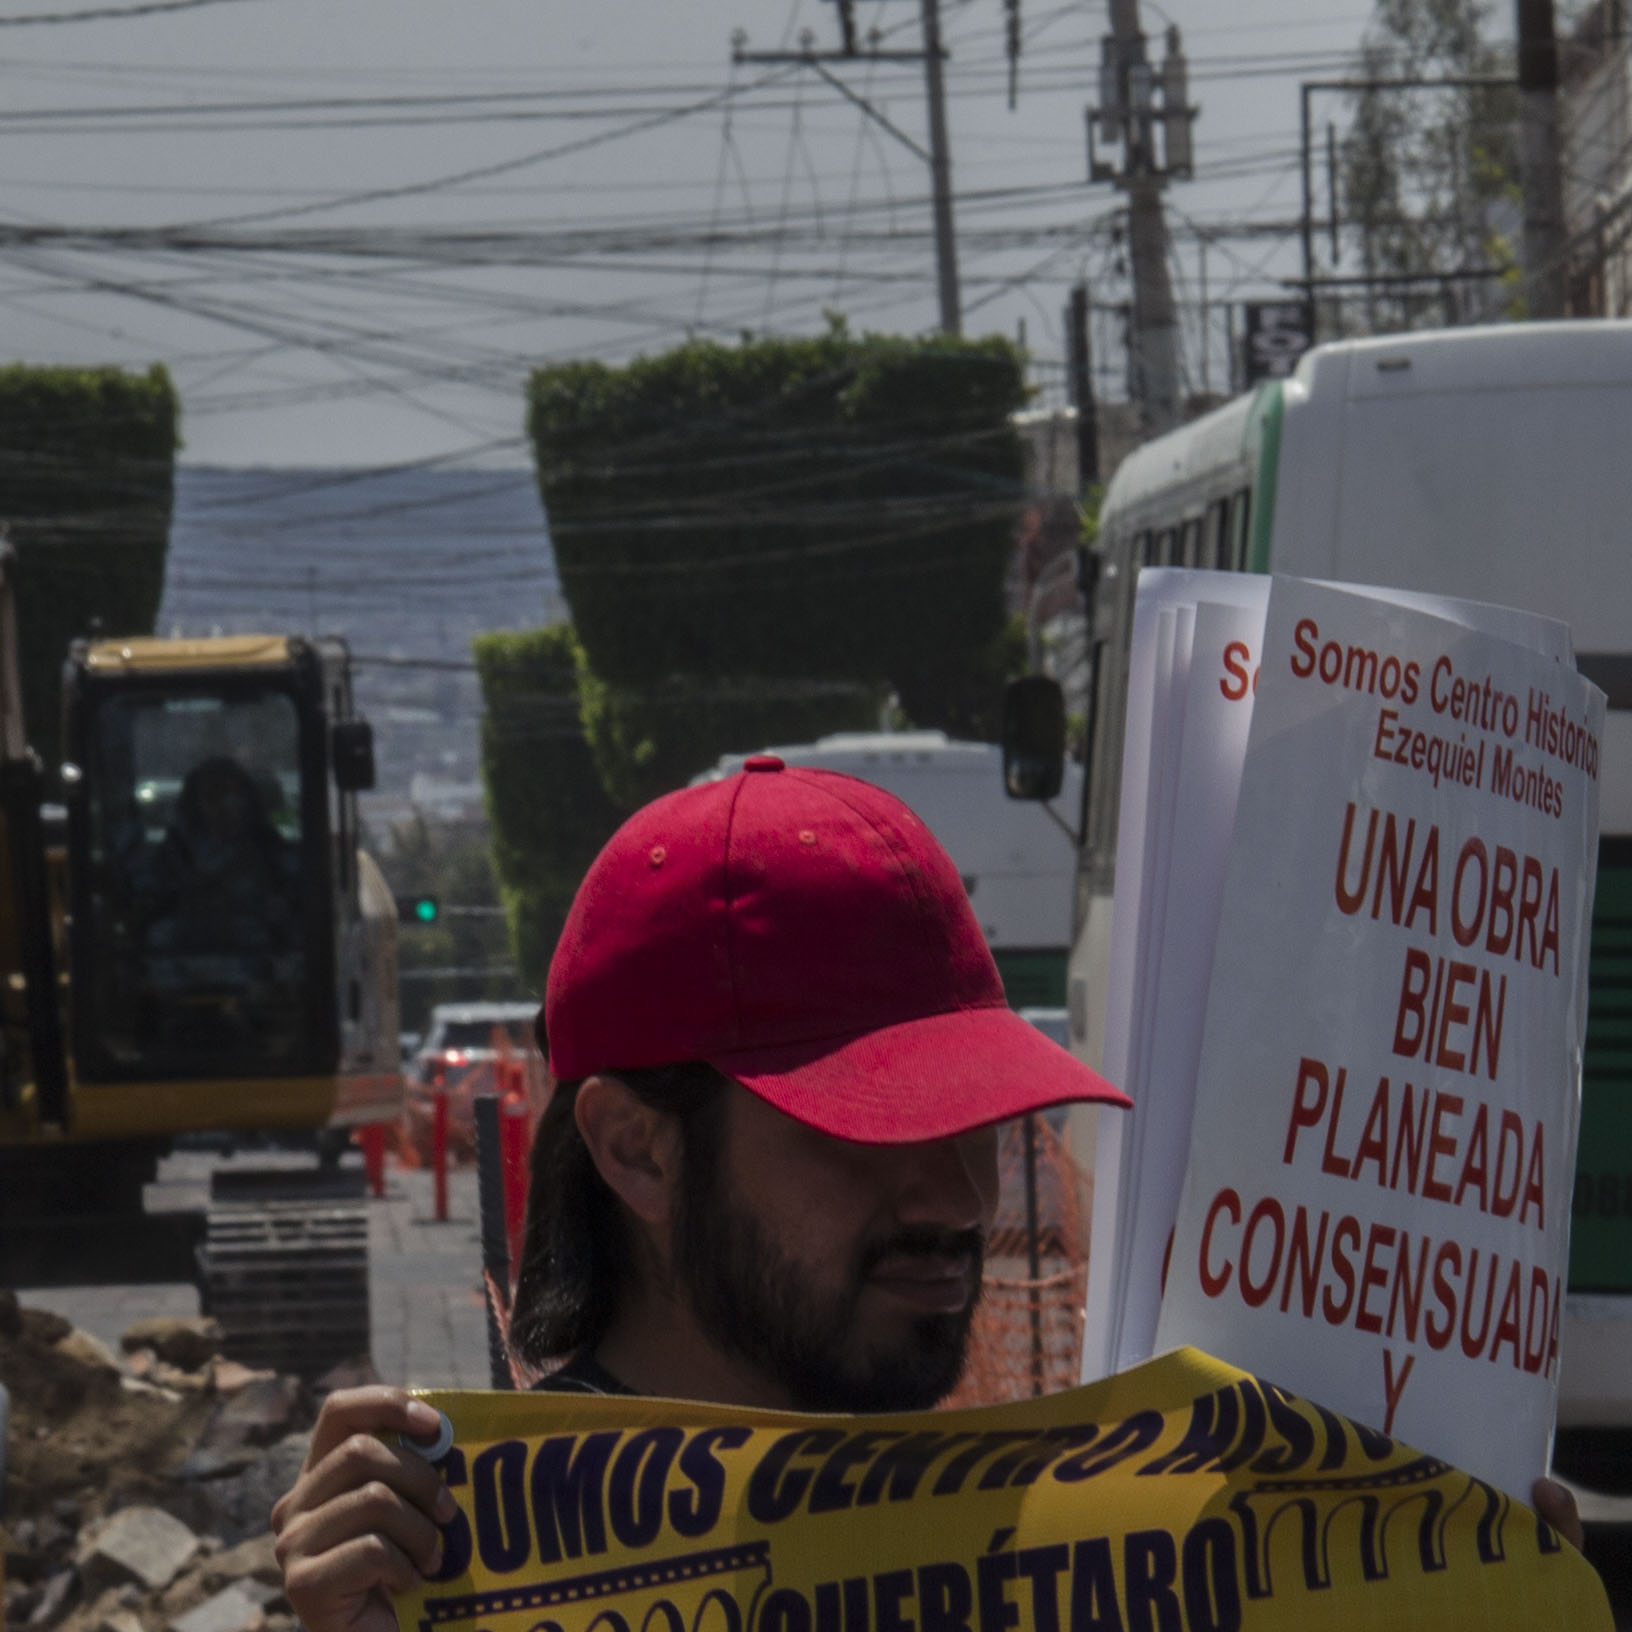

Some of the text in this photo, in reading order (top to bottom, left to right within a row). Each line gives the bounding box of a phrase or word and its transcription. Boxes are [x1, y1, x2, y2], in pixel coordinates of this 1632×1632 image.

[1289, 618, 1599, 782] Somos Centro Historico
[1374, 707, 1564, 819] Ezequiel Montes
[1334, 800, 1562, 978] UNA OBRA
[1392, 947, 1508, 1081] BIEN
[1283, 1057, 1546, 1231] PLANEADA
[1199, 1187, 1562, 1380] CONSENSUADA
[1382, 1347, 1416, 1436] Y
[428, 1425, 755, 1583] SOMOS
[746, 1408, 1166, 1524] CENTRO
